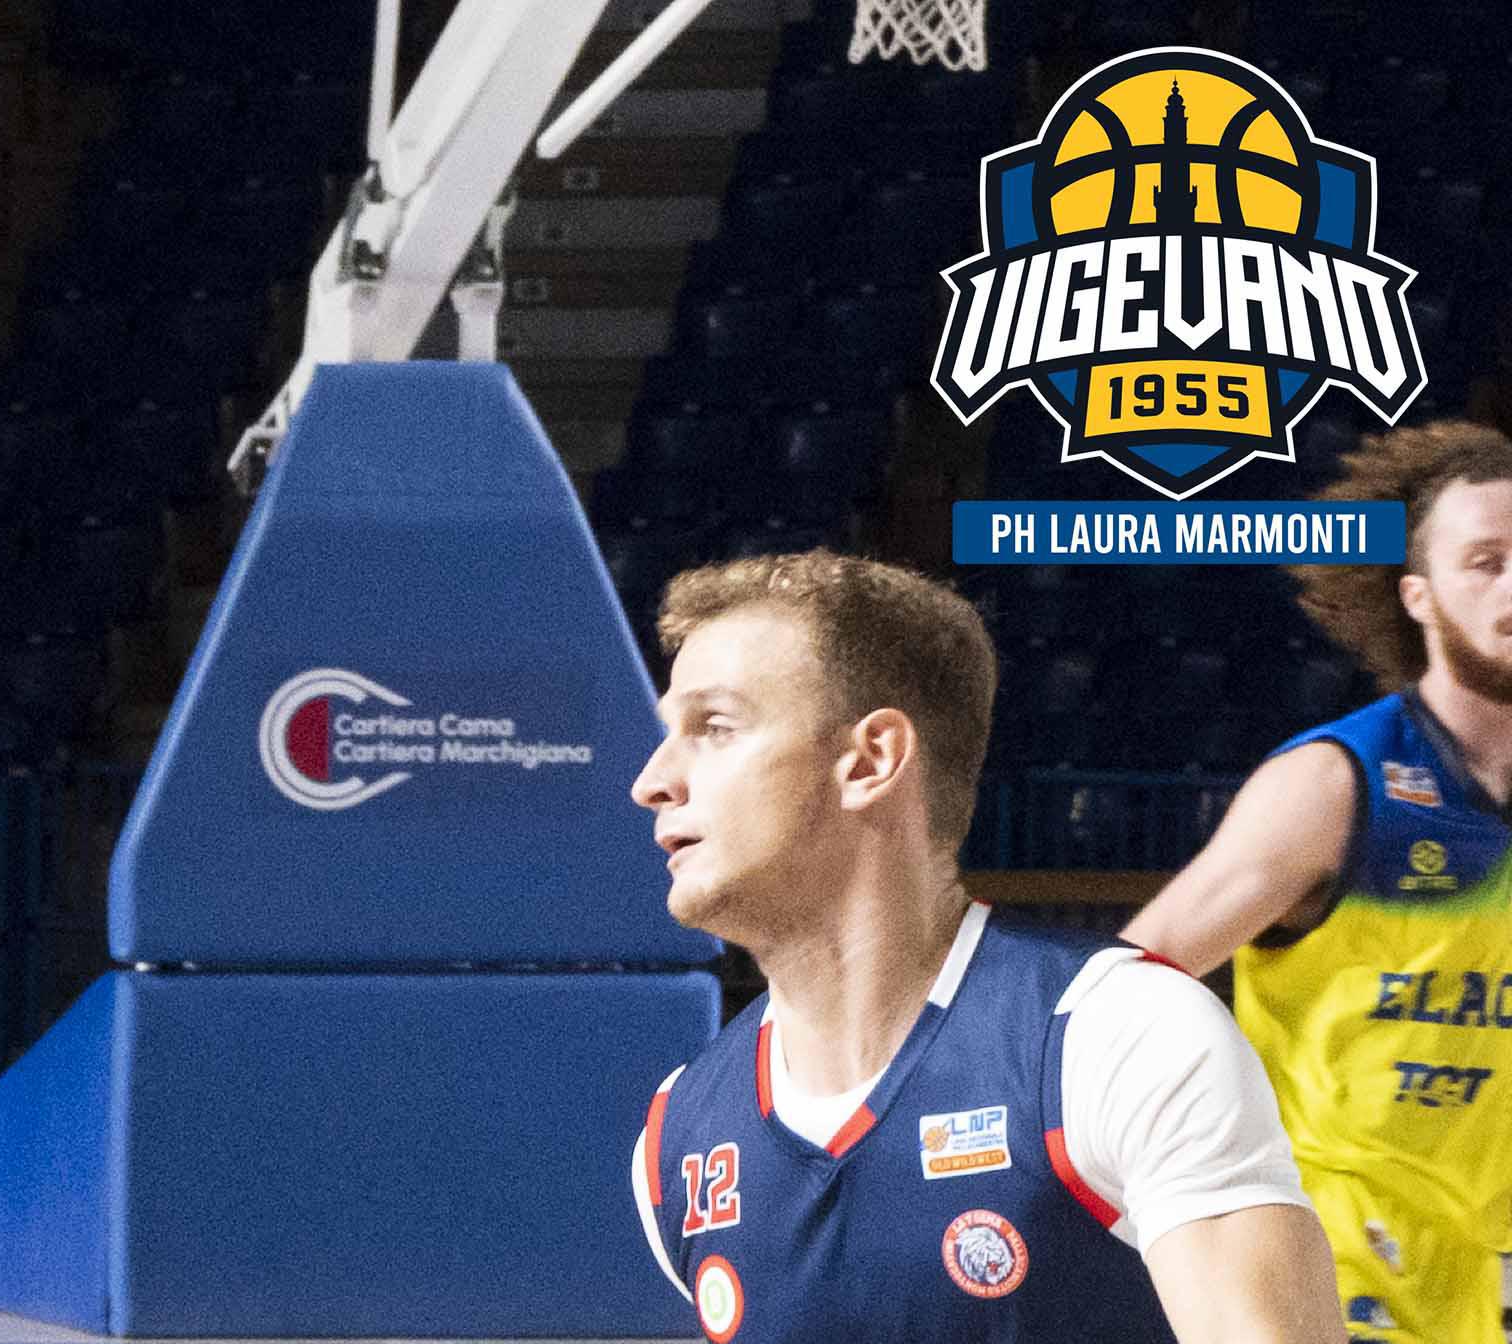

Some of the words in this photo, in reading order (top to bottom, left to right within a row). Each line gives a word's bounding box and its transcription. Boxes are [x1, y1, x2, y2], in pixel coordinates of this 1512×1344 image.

[333, 713, 435, 738] Cartiera
[439, 713, 515, 738] Cama
[333, 739, 435, 764] Cartiera
[439, 739, 593, 769] Marchigiana
[681, 1141, 741, 1238] 12
